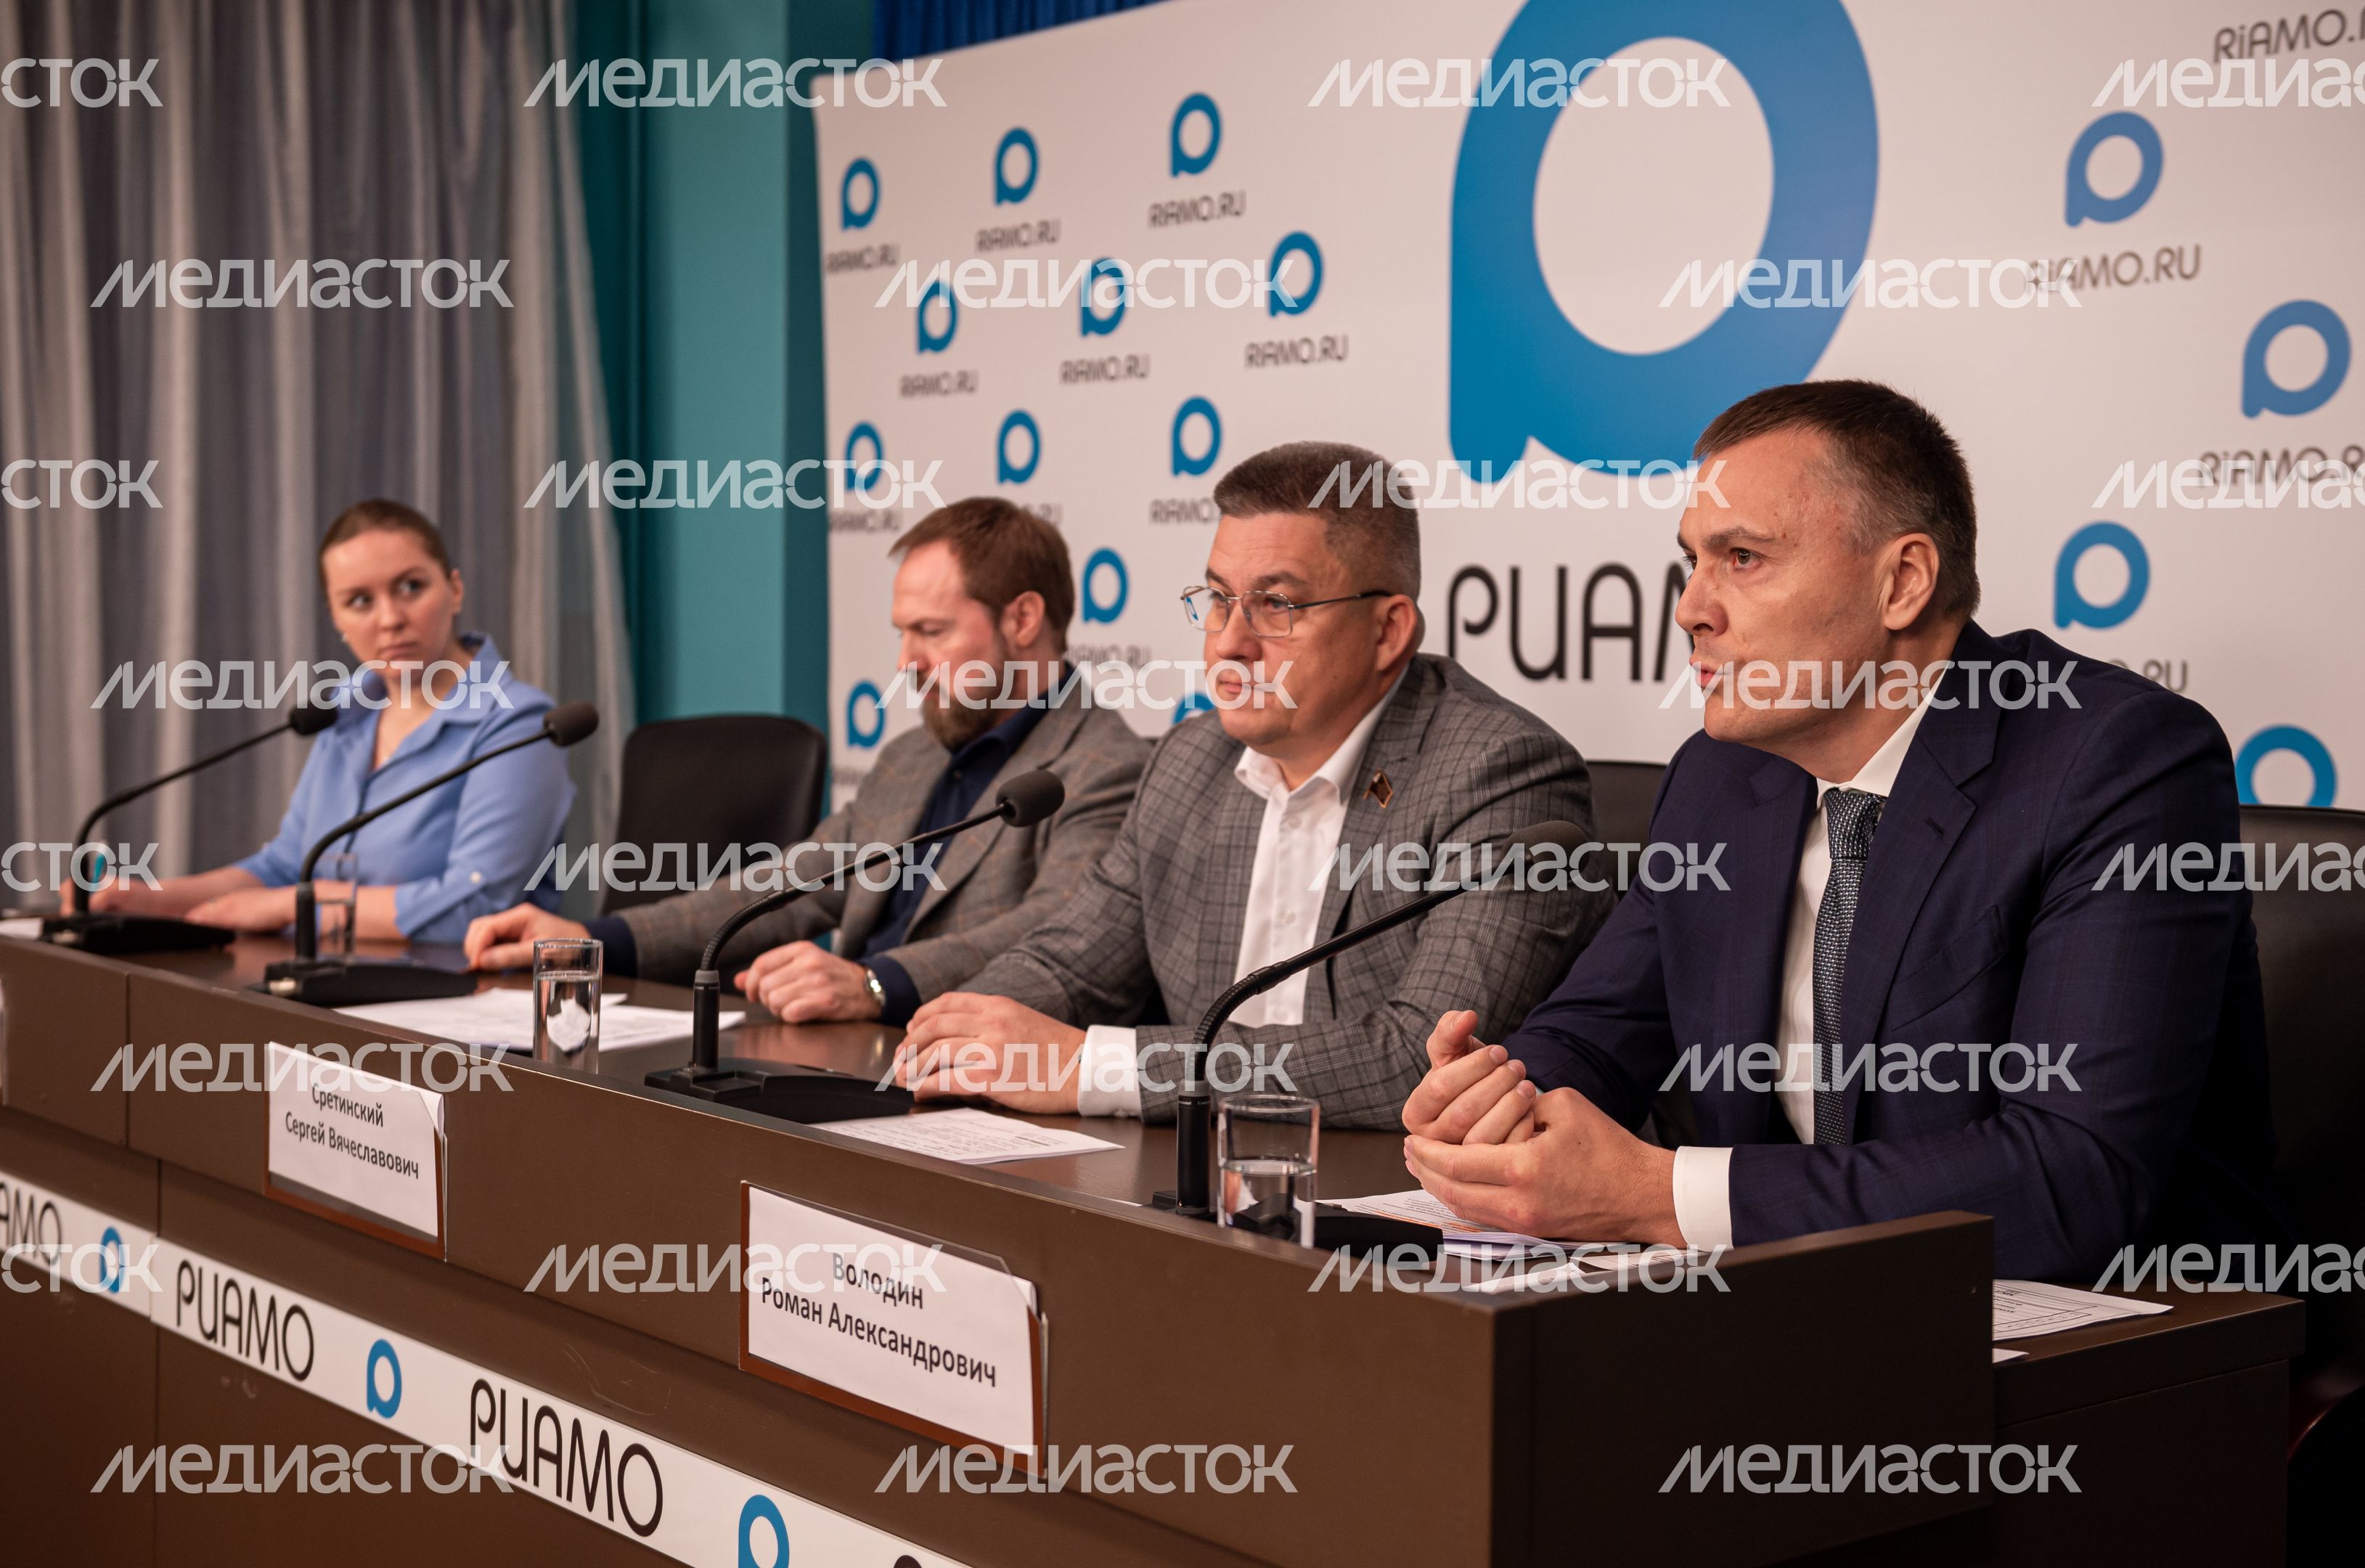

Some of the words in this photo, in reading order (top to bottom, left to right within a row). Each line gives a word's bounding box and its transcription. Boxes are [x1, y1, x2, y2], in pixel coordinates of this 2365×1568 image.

[2213, 6, 2365, 64] RiAMO.
[312, 1082, 384, 1127] Сретинский
[285, 1111, 325, 1146] Сергей
[328, 1127, 420, 1180] Вячеславович
[833, 1251, 924, 1309] Володин
[176, 1259, 314, 1381] РИАМО
[761, 1276, 822, 1324] Роман
[828, 1302, 997, 1387] Александрович
[470, 1379, 663, 1538] РИАМО
